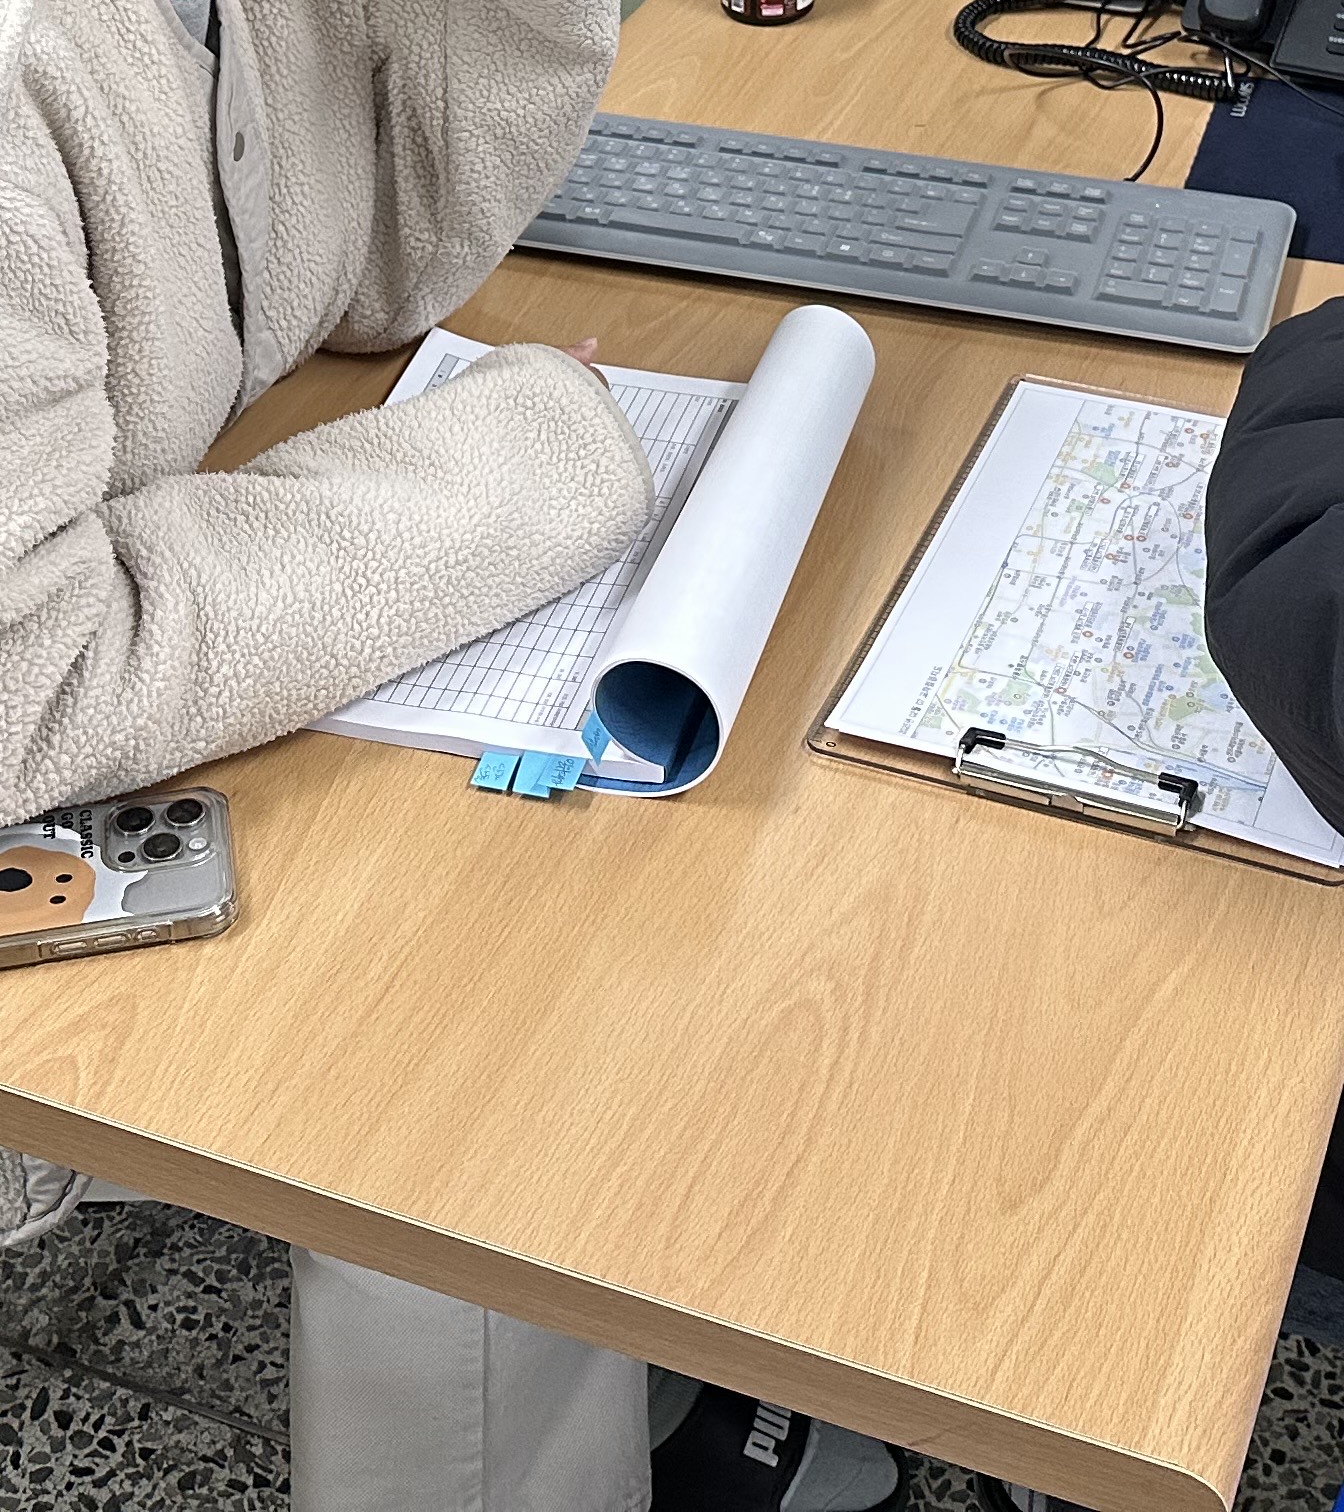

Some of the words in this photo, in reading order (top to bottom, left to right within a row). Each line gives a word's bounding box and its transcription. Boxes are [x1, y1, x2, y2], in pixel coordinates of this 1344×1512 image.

[43, 815, 55, 839] OUT
[61, 813, 73, 828] GO
[80, 810, 93, 859] CLASSIC
[743, 1400, 792, 1467] PU
